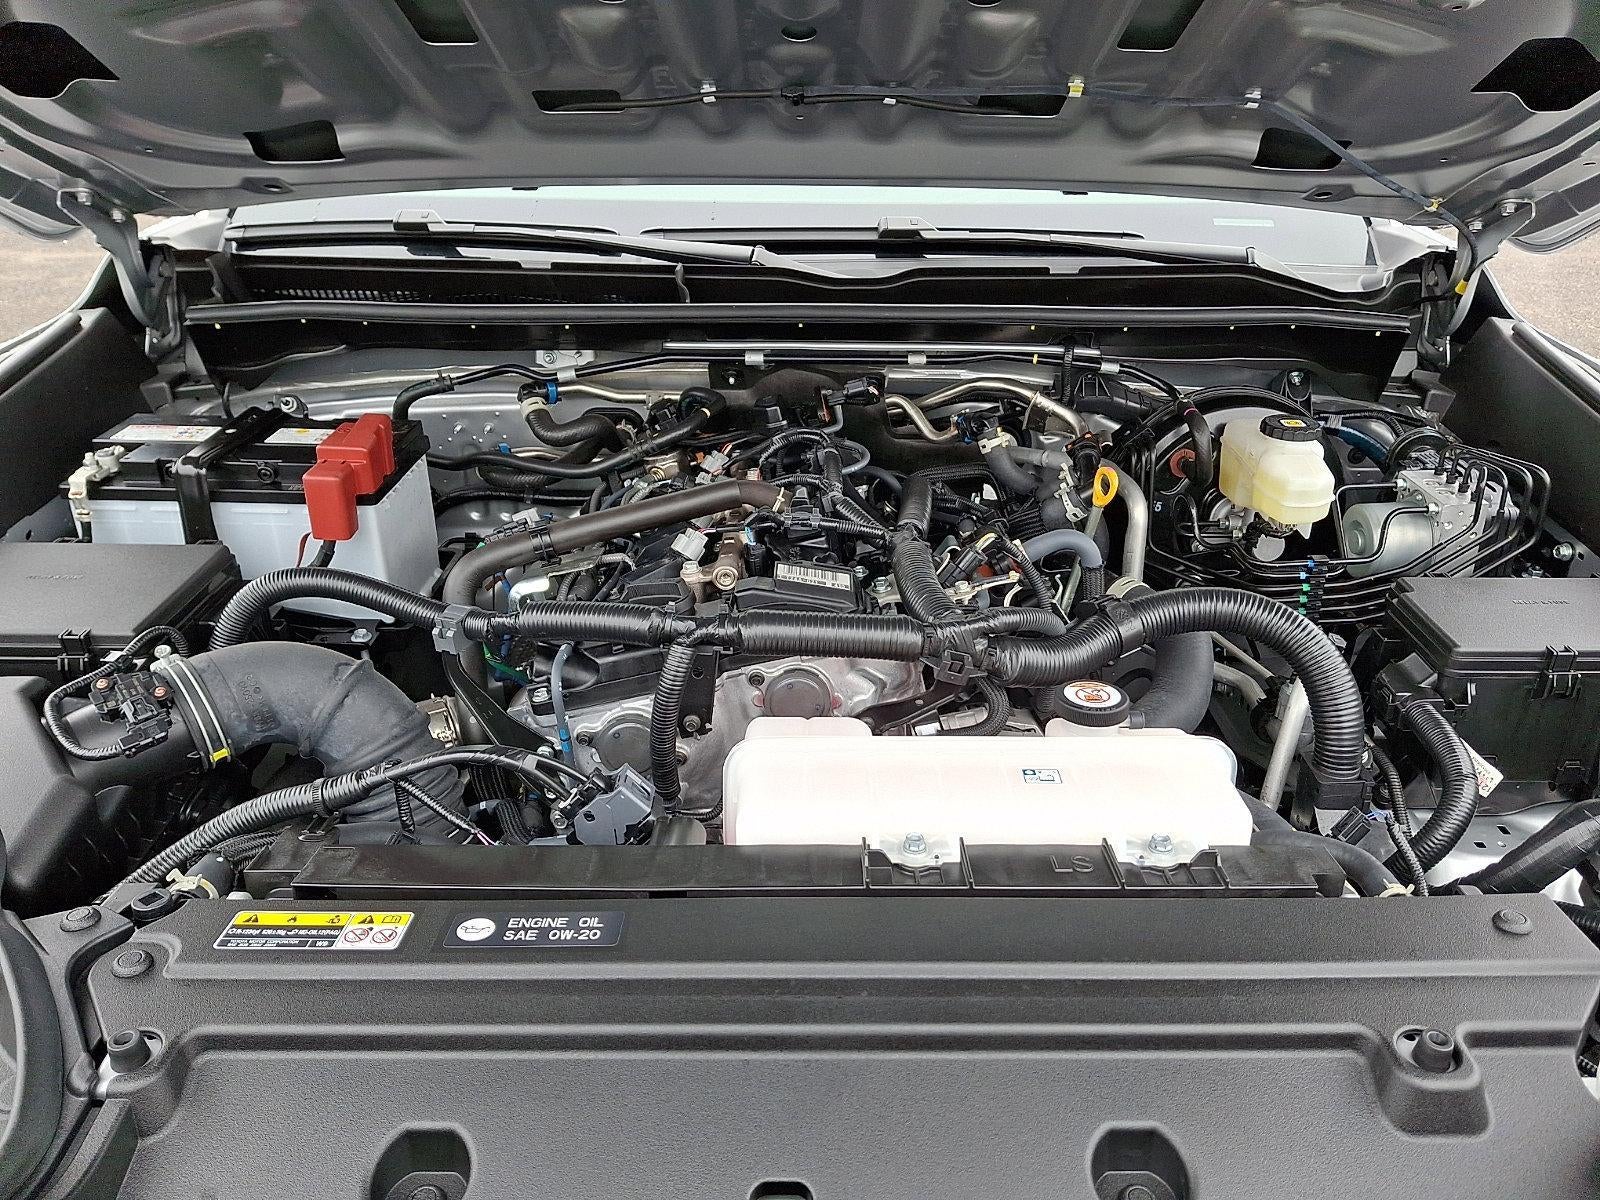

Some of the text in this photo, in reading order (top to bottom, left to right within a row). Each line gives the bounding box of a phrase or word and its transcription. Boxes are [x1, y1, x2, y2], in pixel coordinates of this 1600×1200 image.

[1050, 855, 1094, 872] LS
[507, 917, 604, 928] ENGINE OIL
[503, 929, 602, 941] SAE 0W-20
